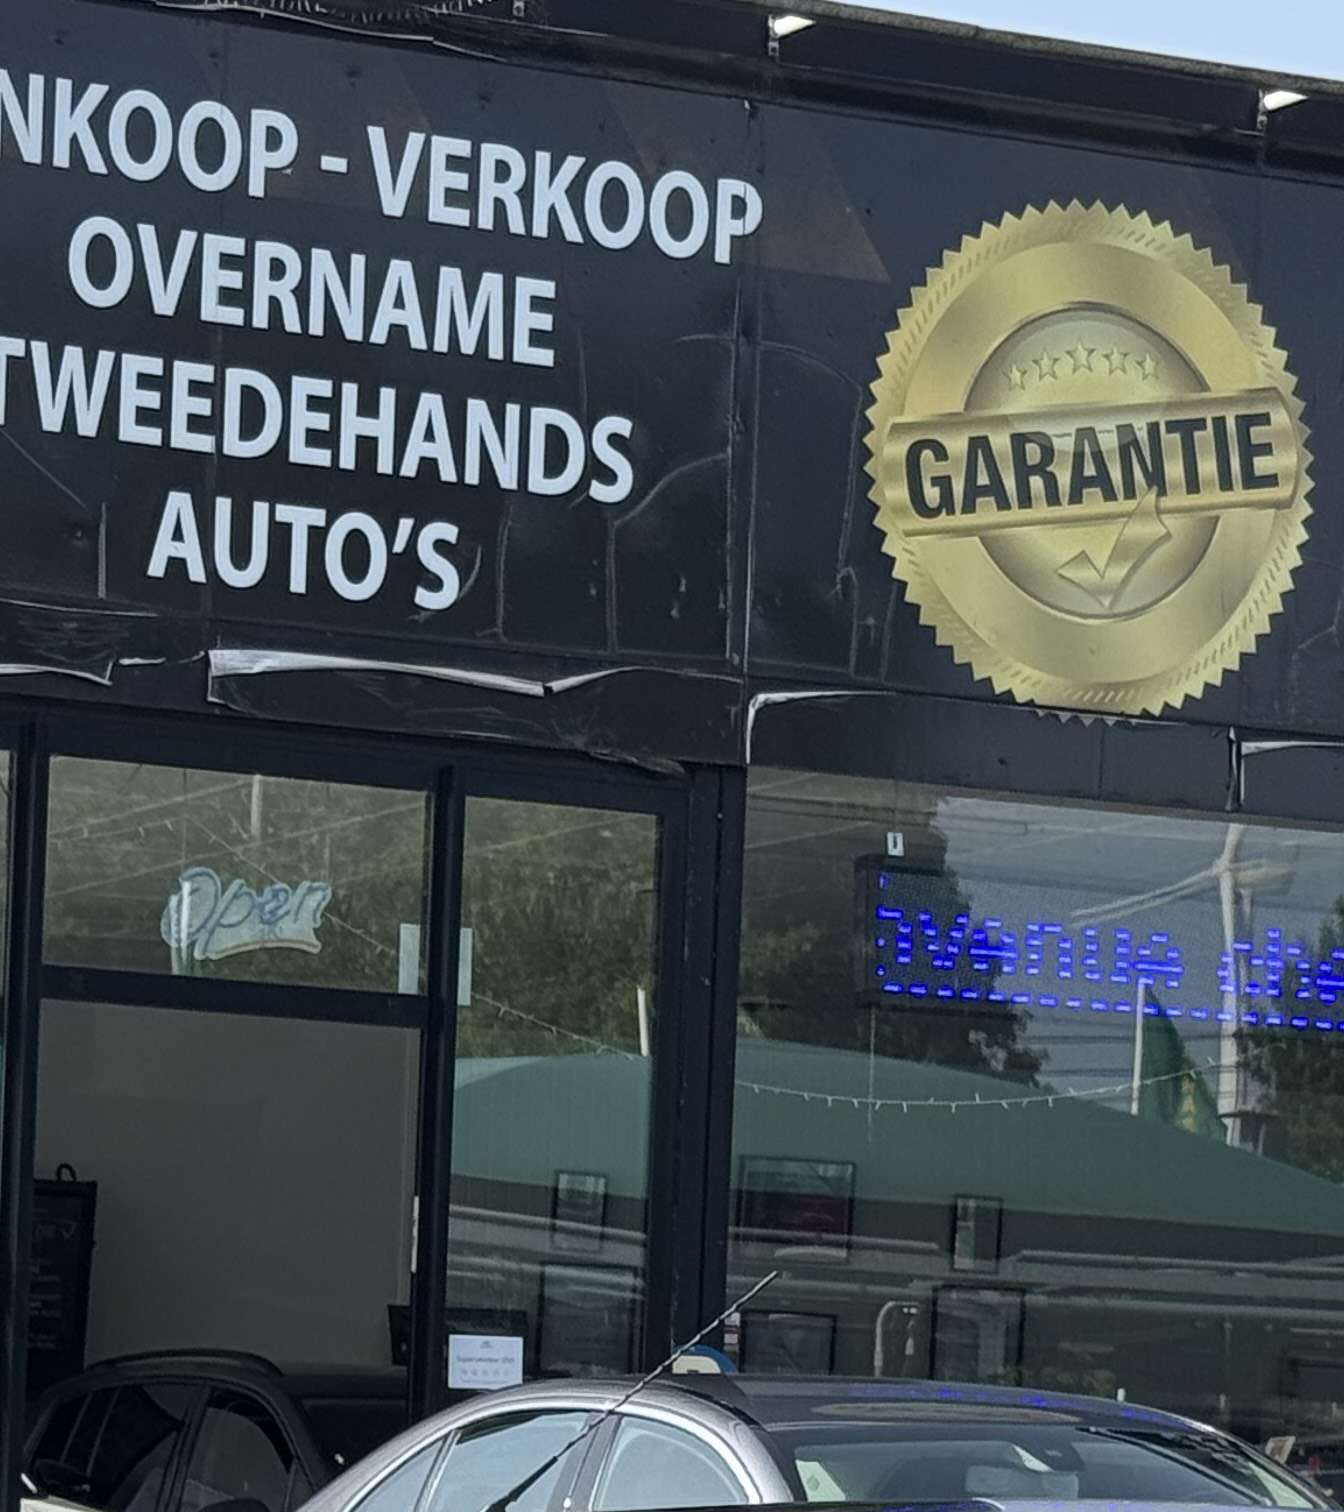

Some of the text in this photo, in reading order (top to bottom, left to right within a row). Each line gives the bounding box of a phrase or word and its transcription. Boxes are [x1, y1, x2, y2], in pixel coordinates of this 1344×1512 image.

[320, 154, 348, 174] -
[367, 125, 763, 265] VERKOOP
[68, 216, 557, 367] OVERNAME
[904, 412, 1280, 519] GARANTIE
[160, 866, 332, 961] Open
